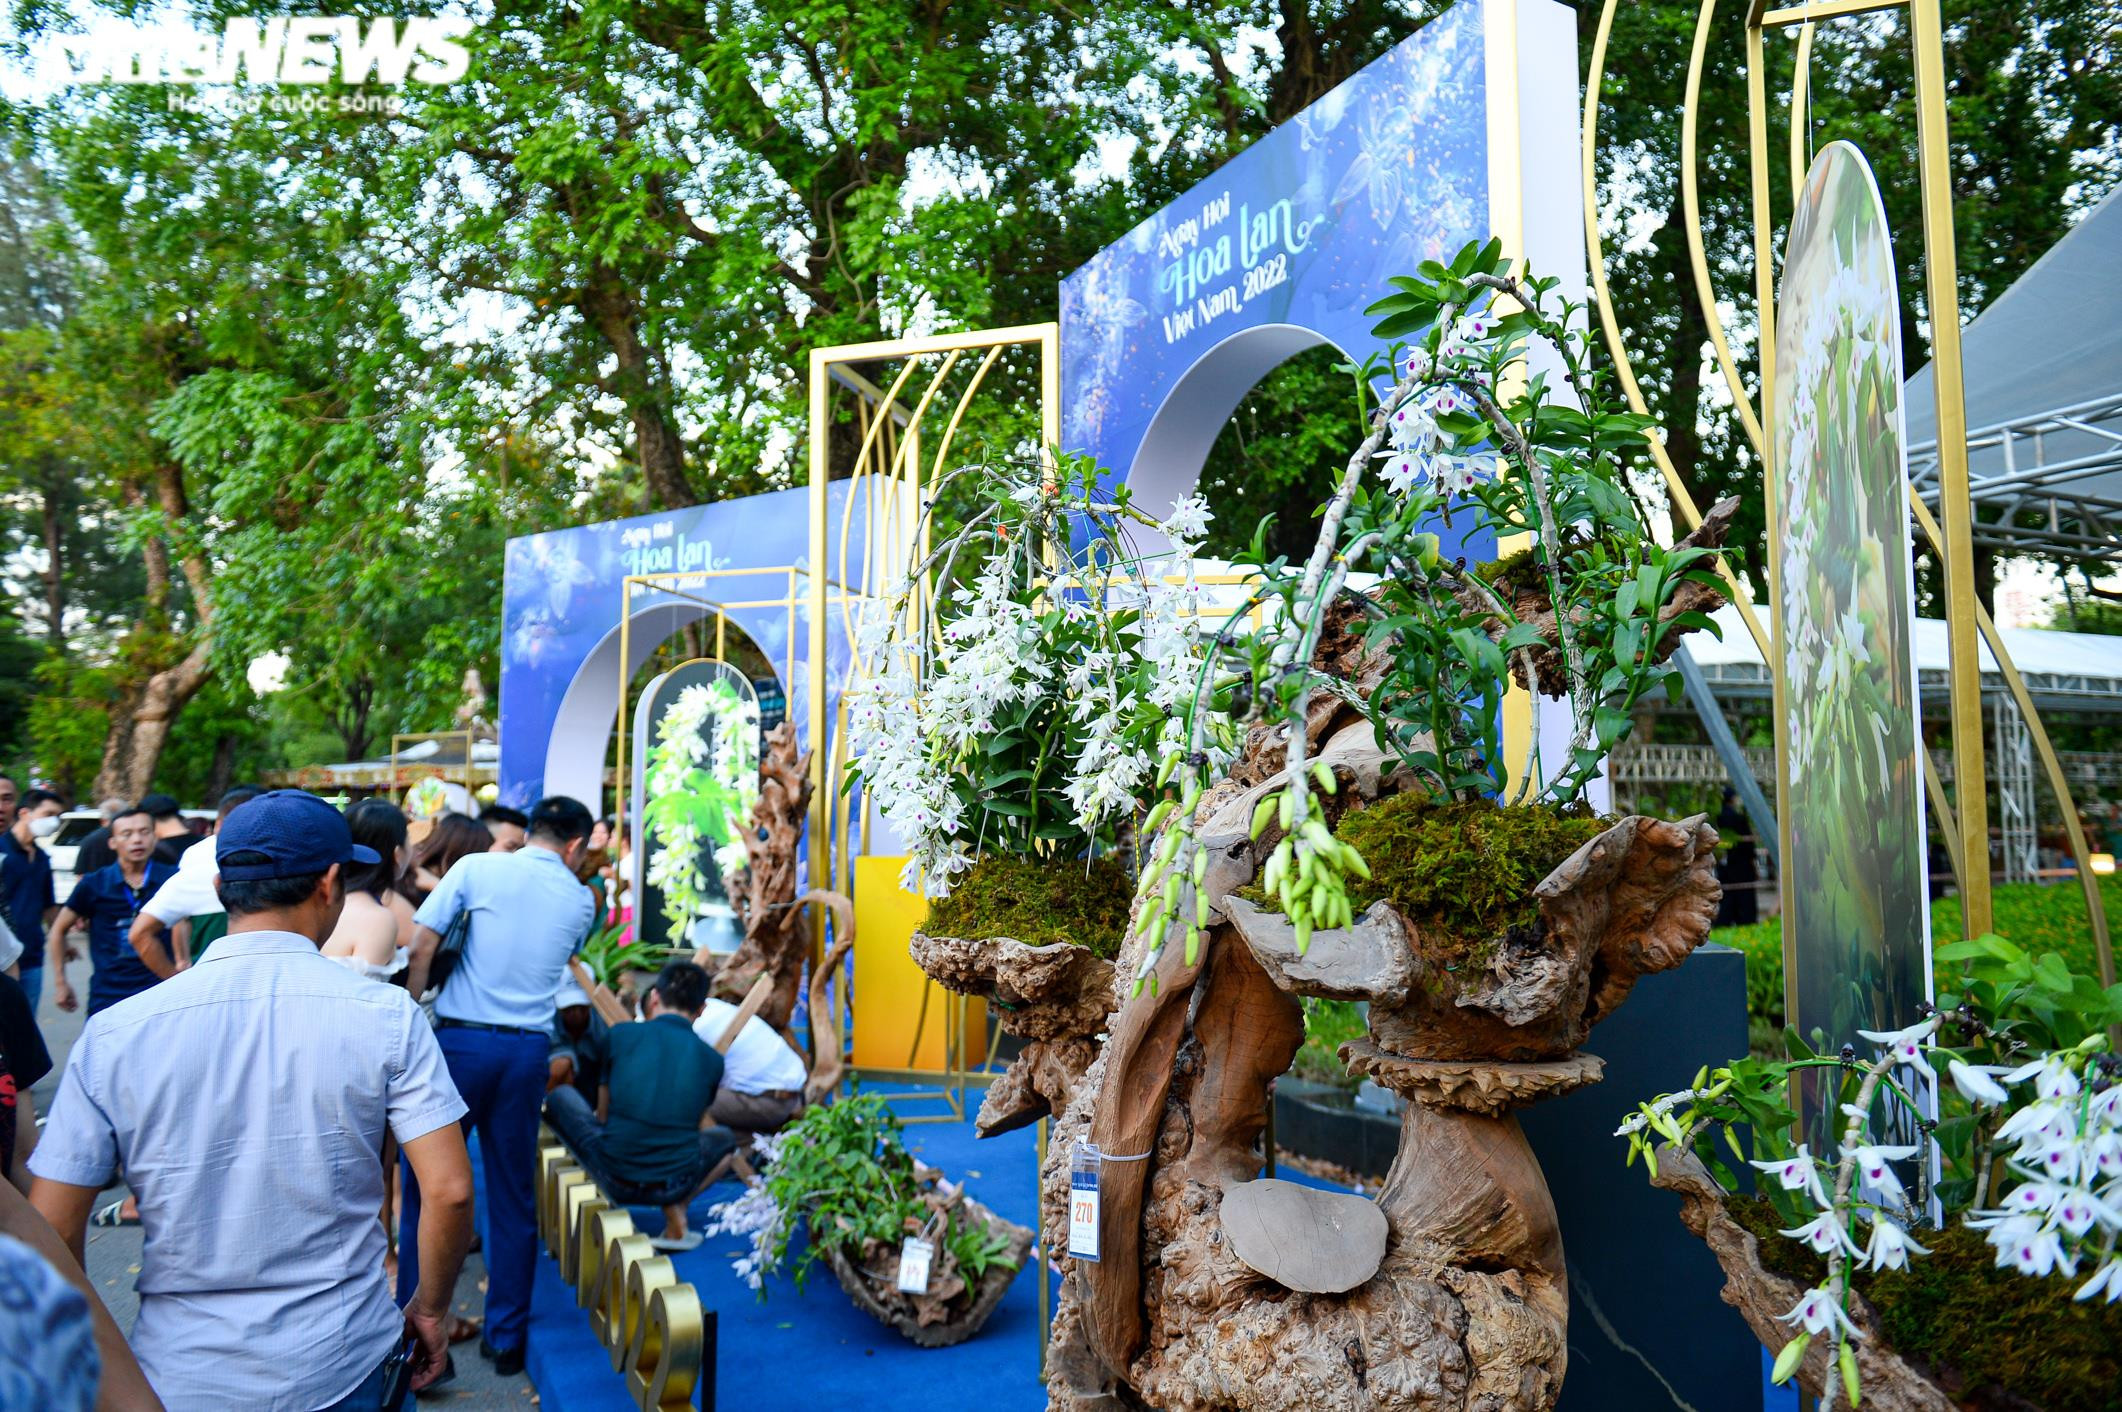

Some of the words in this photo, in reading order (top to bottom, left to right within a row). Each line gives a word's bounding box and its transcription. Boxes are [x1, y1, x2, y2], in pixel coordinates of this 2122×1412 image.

[1159, 235, 1231, 306] Hoa
[1198, 286, 1243, 325] Nam
[1243, 253, 1287, 301] 2022
[621, 546, 673, 576] Hoa
[1075, 1201, 1093, 1224] 270
